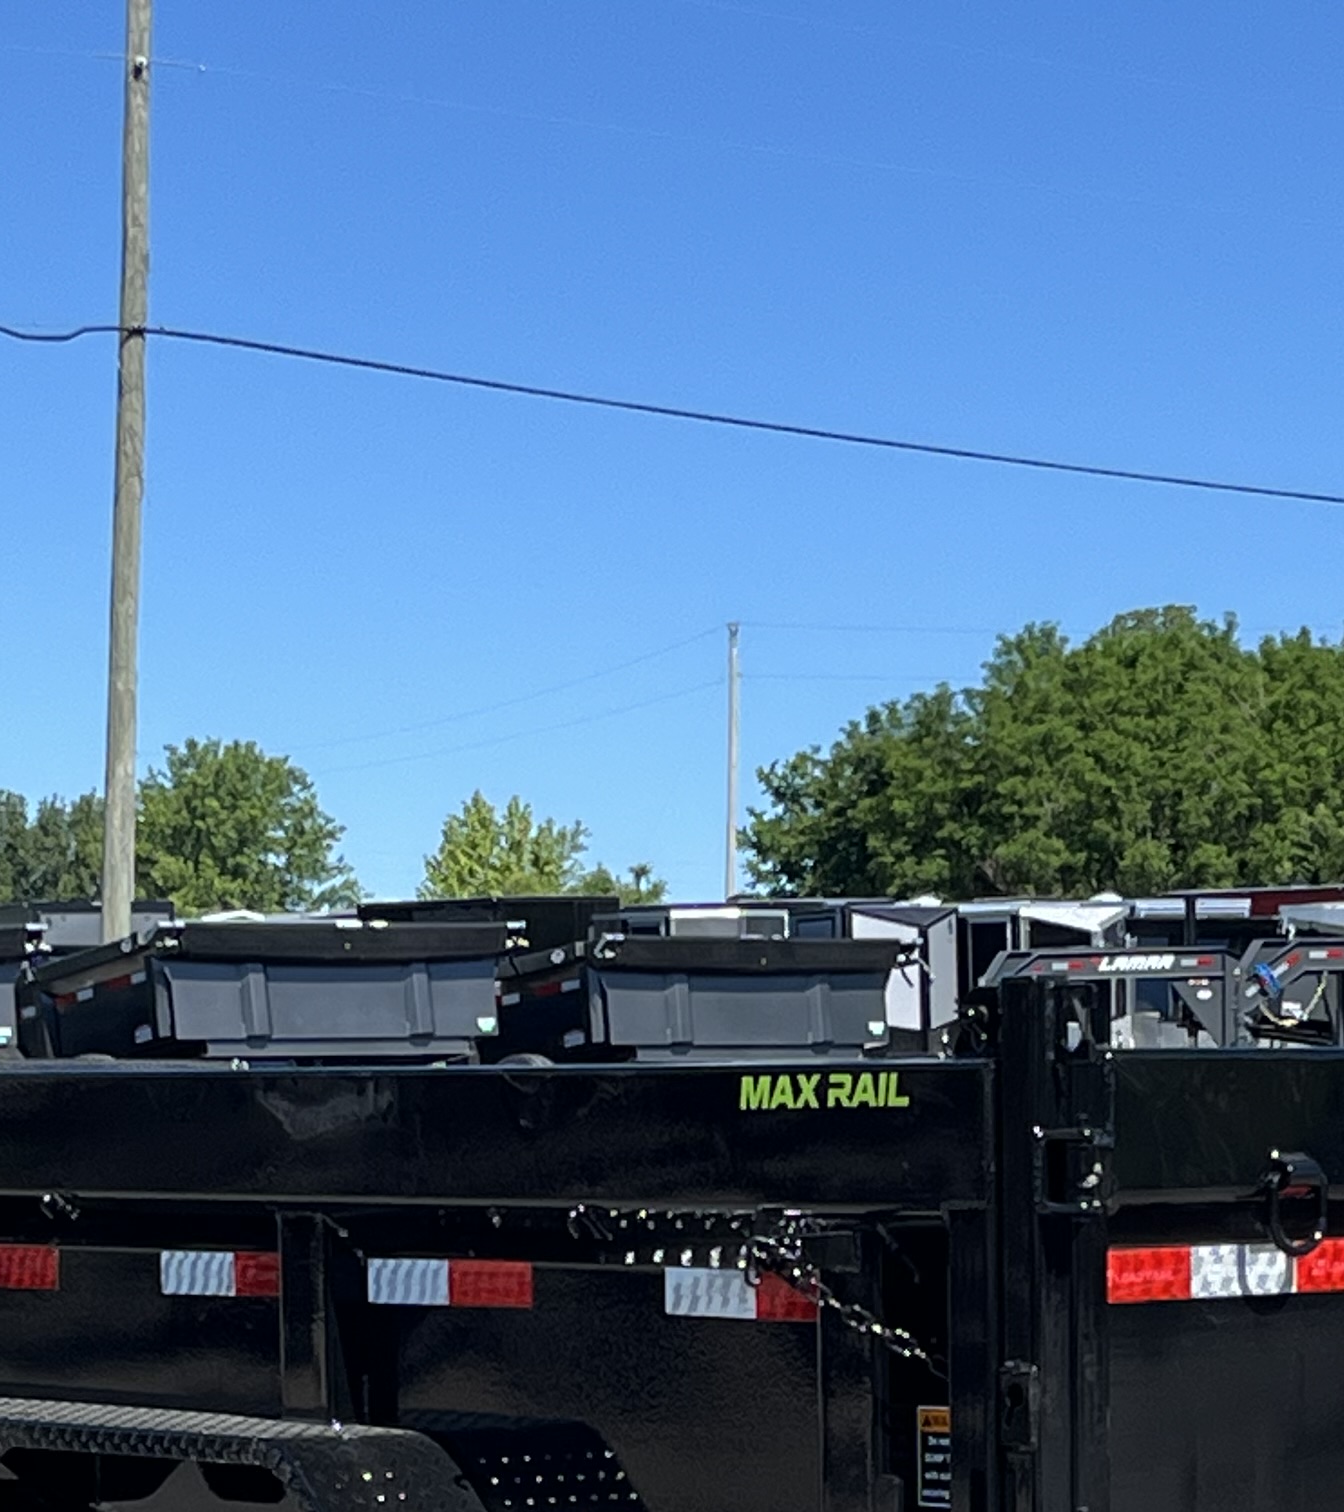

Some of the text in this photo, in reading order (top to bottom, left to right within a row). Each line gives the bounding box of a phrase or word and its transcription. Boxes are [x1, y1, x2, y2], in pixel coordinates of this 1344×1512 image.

[1098, 954, 1176, 972] LAMAR
[739, 1071, 910, 1111] MAX RAIL
